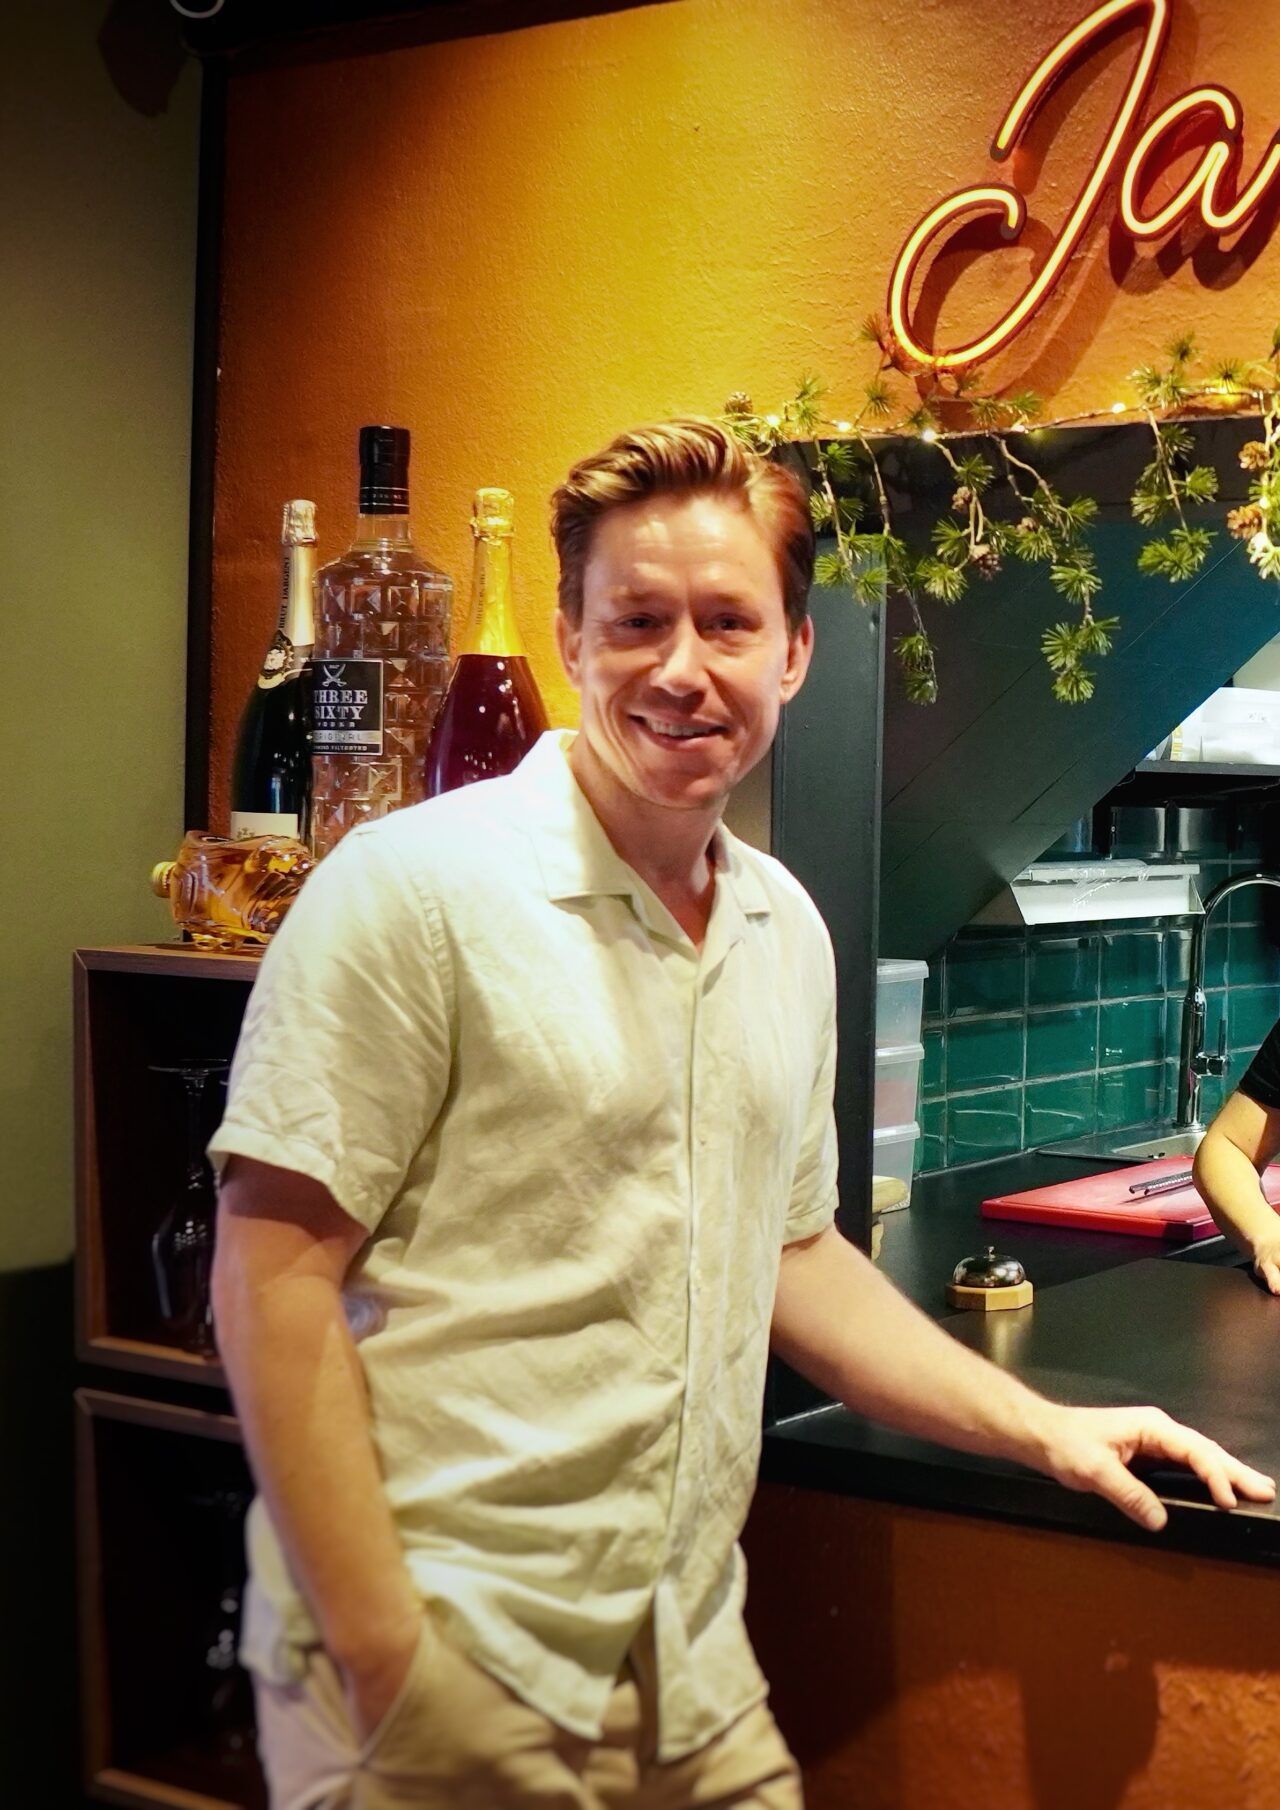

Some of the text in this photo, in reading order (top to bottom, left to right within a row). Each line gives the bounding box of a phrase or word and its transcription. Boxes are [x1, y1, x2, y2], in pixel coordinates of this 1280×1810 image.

[278, 605, 288, 629] BRUT
[313, 689, 368, 704] THREE
[314, 705, 365, 720] SIXTY
